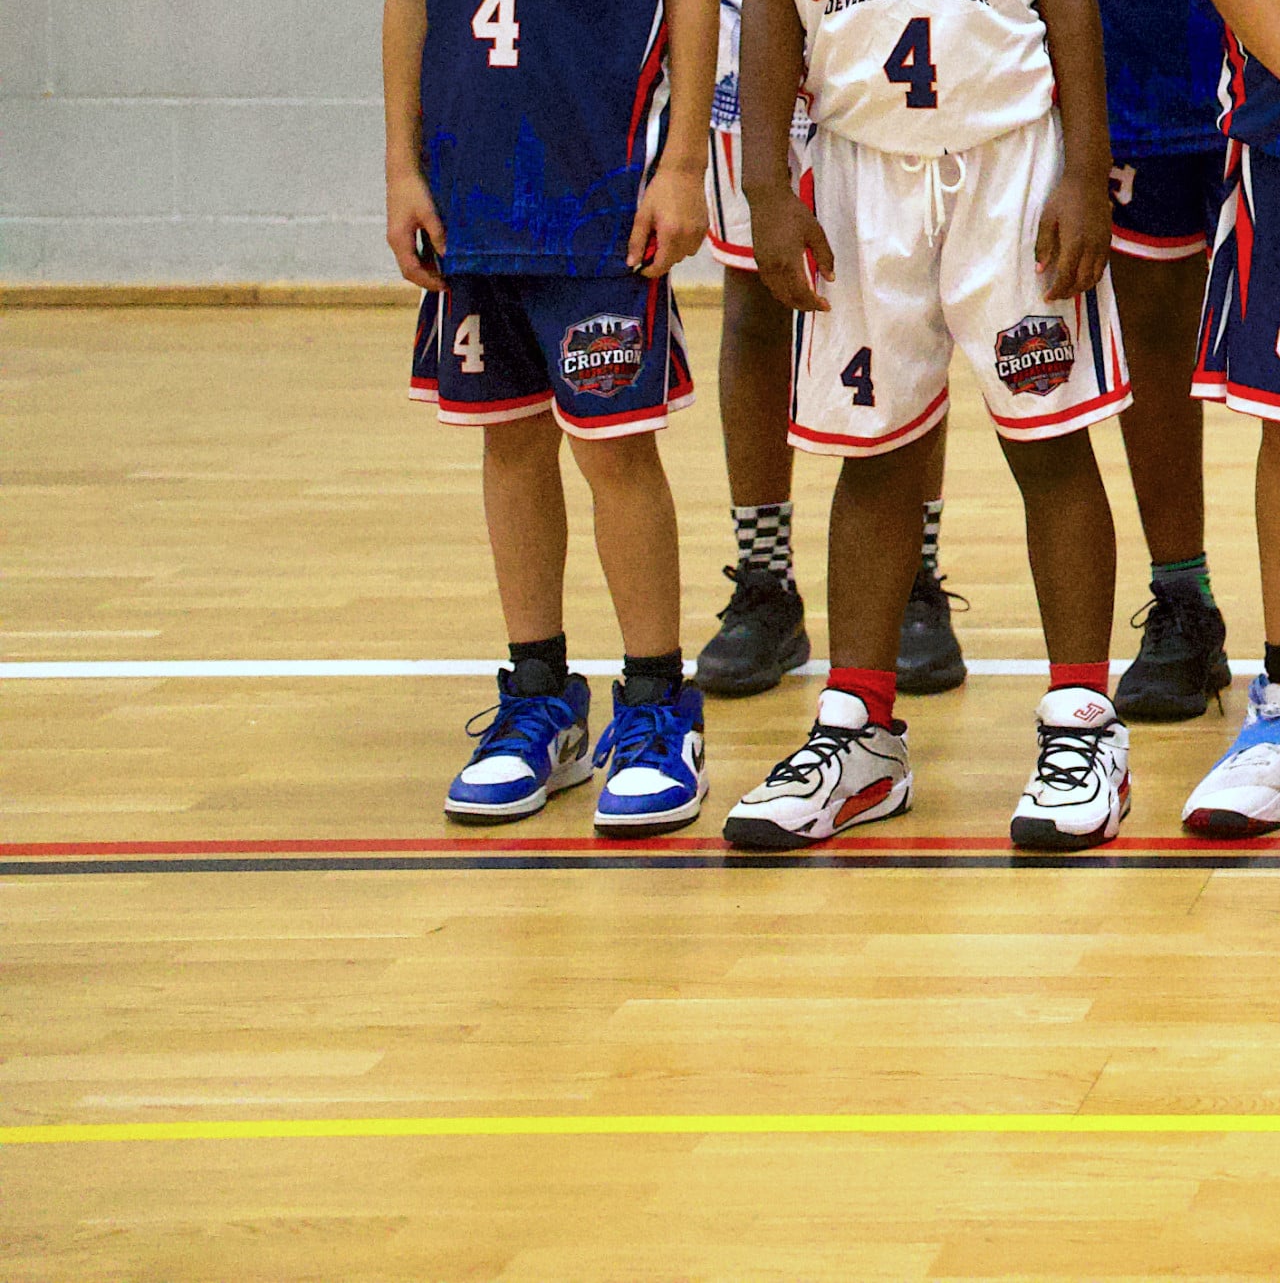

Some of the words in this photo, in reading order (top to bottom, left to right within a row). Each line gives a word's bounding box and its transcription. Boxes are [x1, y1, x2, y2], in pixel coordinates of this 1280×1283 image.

[883, 17, 938, 110] 4
[452, 314, 485, 374] 4
[564, 349, 642, 374] CROYDON
[998, 345, 1074, 378] CROYDON
[840, 346, 876, 408] 4
